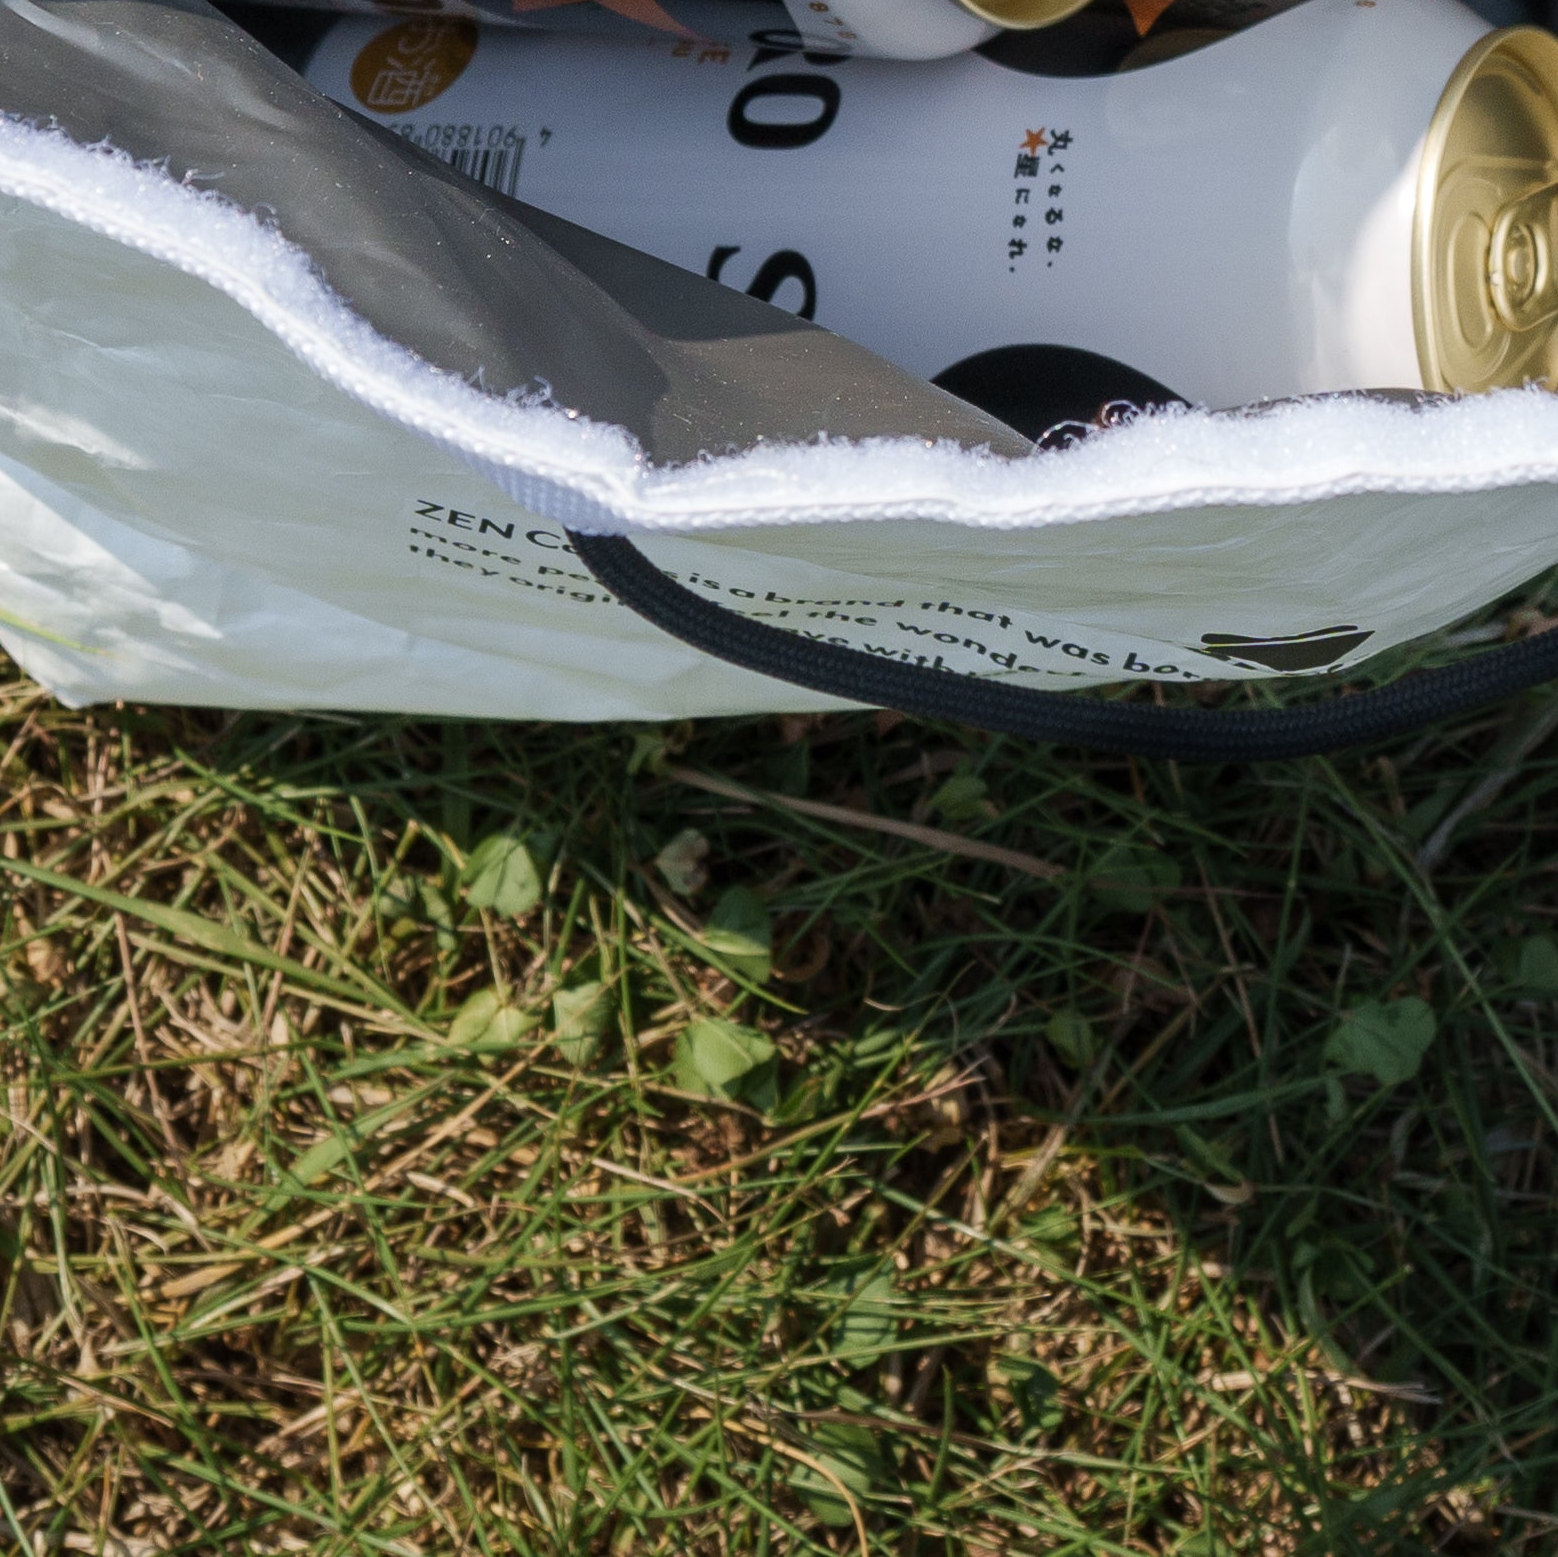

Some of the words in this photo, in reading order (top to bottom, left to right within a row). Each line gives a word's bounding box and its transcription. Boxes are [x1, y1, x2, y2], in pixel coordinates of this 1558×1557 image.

[409, 544, 500, 577] they
[410, 528, 522, 565] more
[806, 611, 877, 626] the
[414, 499, 515, 541] ZEN
[689, 572, 721, 590] is
[729, 588, 755, 599] a
[765, 591, 906, 608] brand
[920, 601, 1012, 629] that
[1024, 629, 1110, 666] was
[1123, 652, 1211, 681] bor
